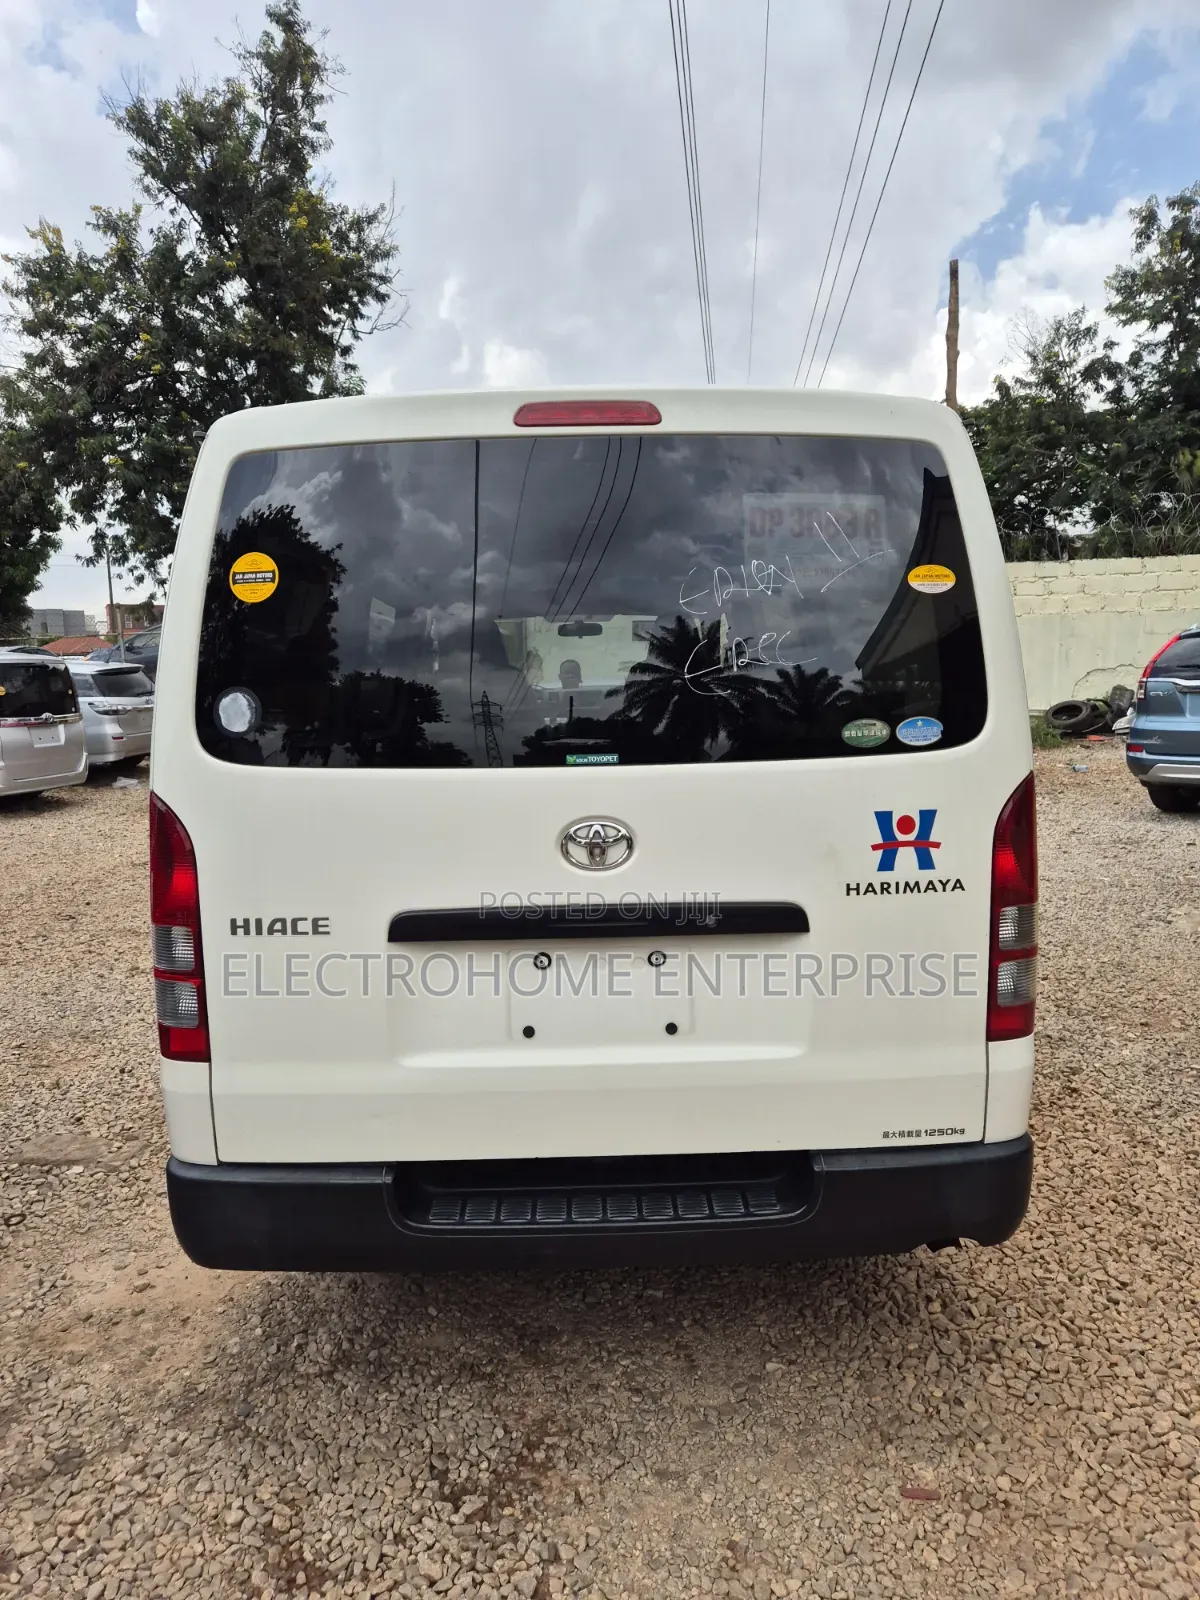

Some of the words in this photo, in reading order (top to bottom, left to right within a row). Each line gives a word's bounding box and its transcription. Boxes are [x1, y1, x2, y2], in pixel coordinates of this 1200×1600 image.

[587, 755, 618, 763] TOYOPET
[845, 878, 966, 897] HARIMAYA
[229, 916, 331, 936] HIACE
[882, 1130, 922, 1139] 最大積載量
[923, 1127, 966, 1137] 1250kg
